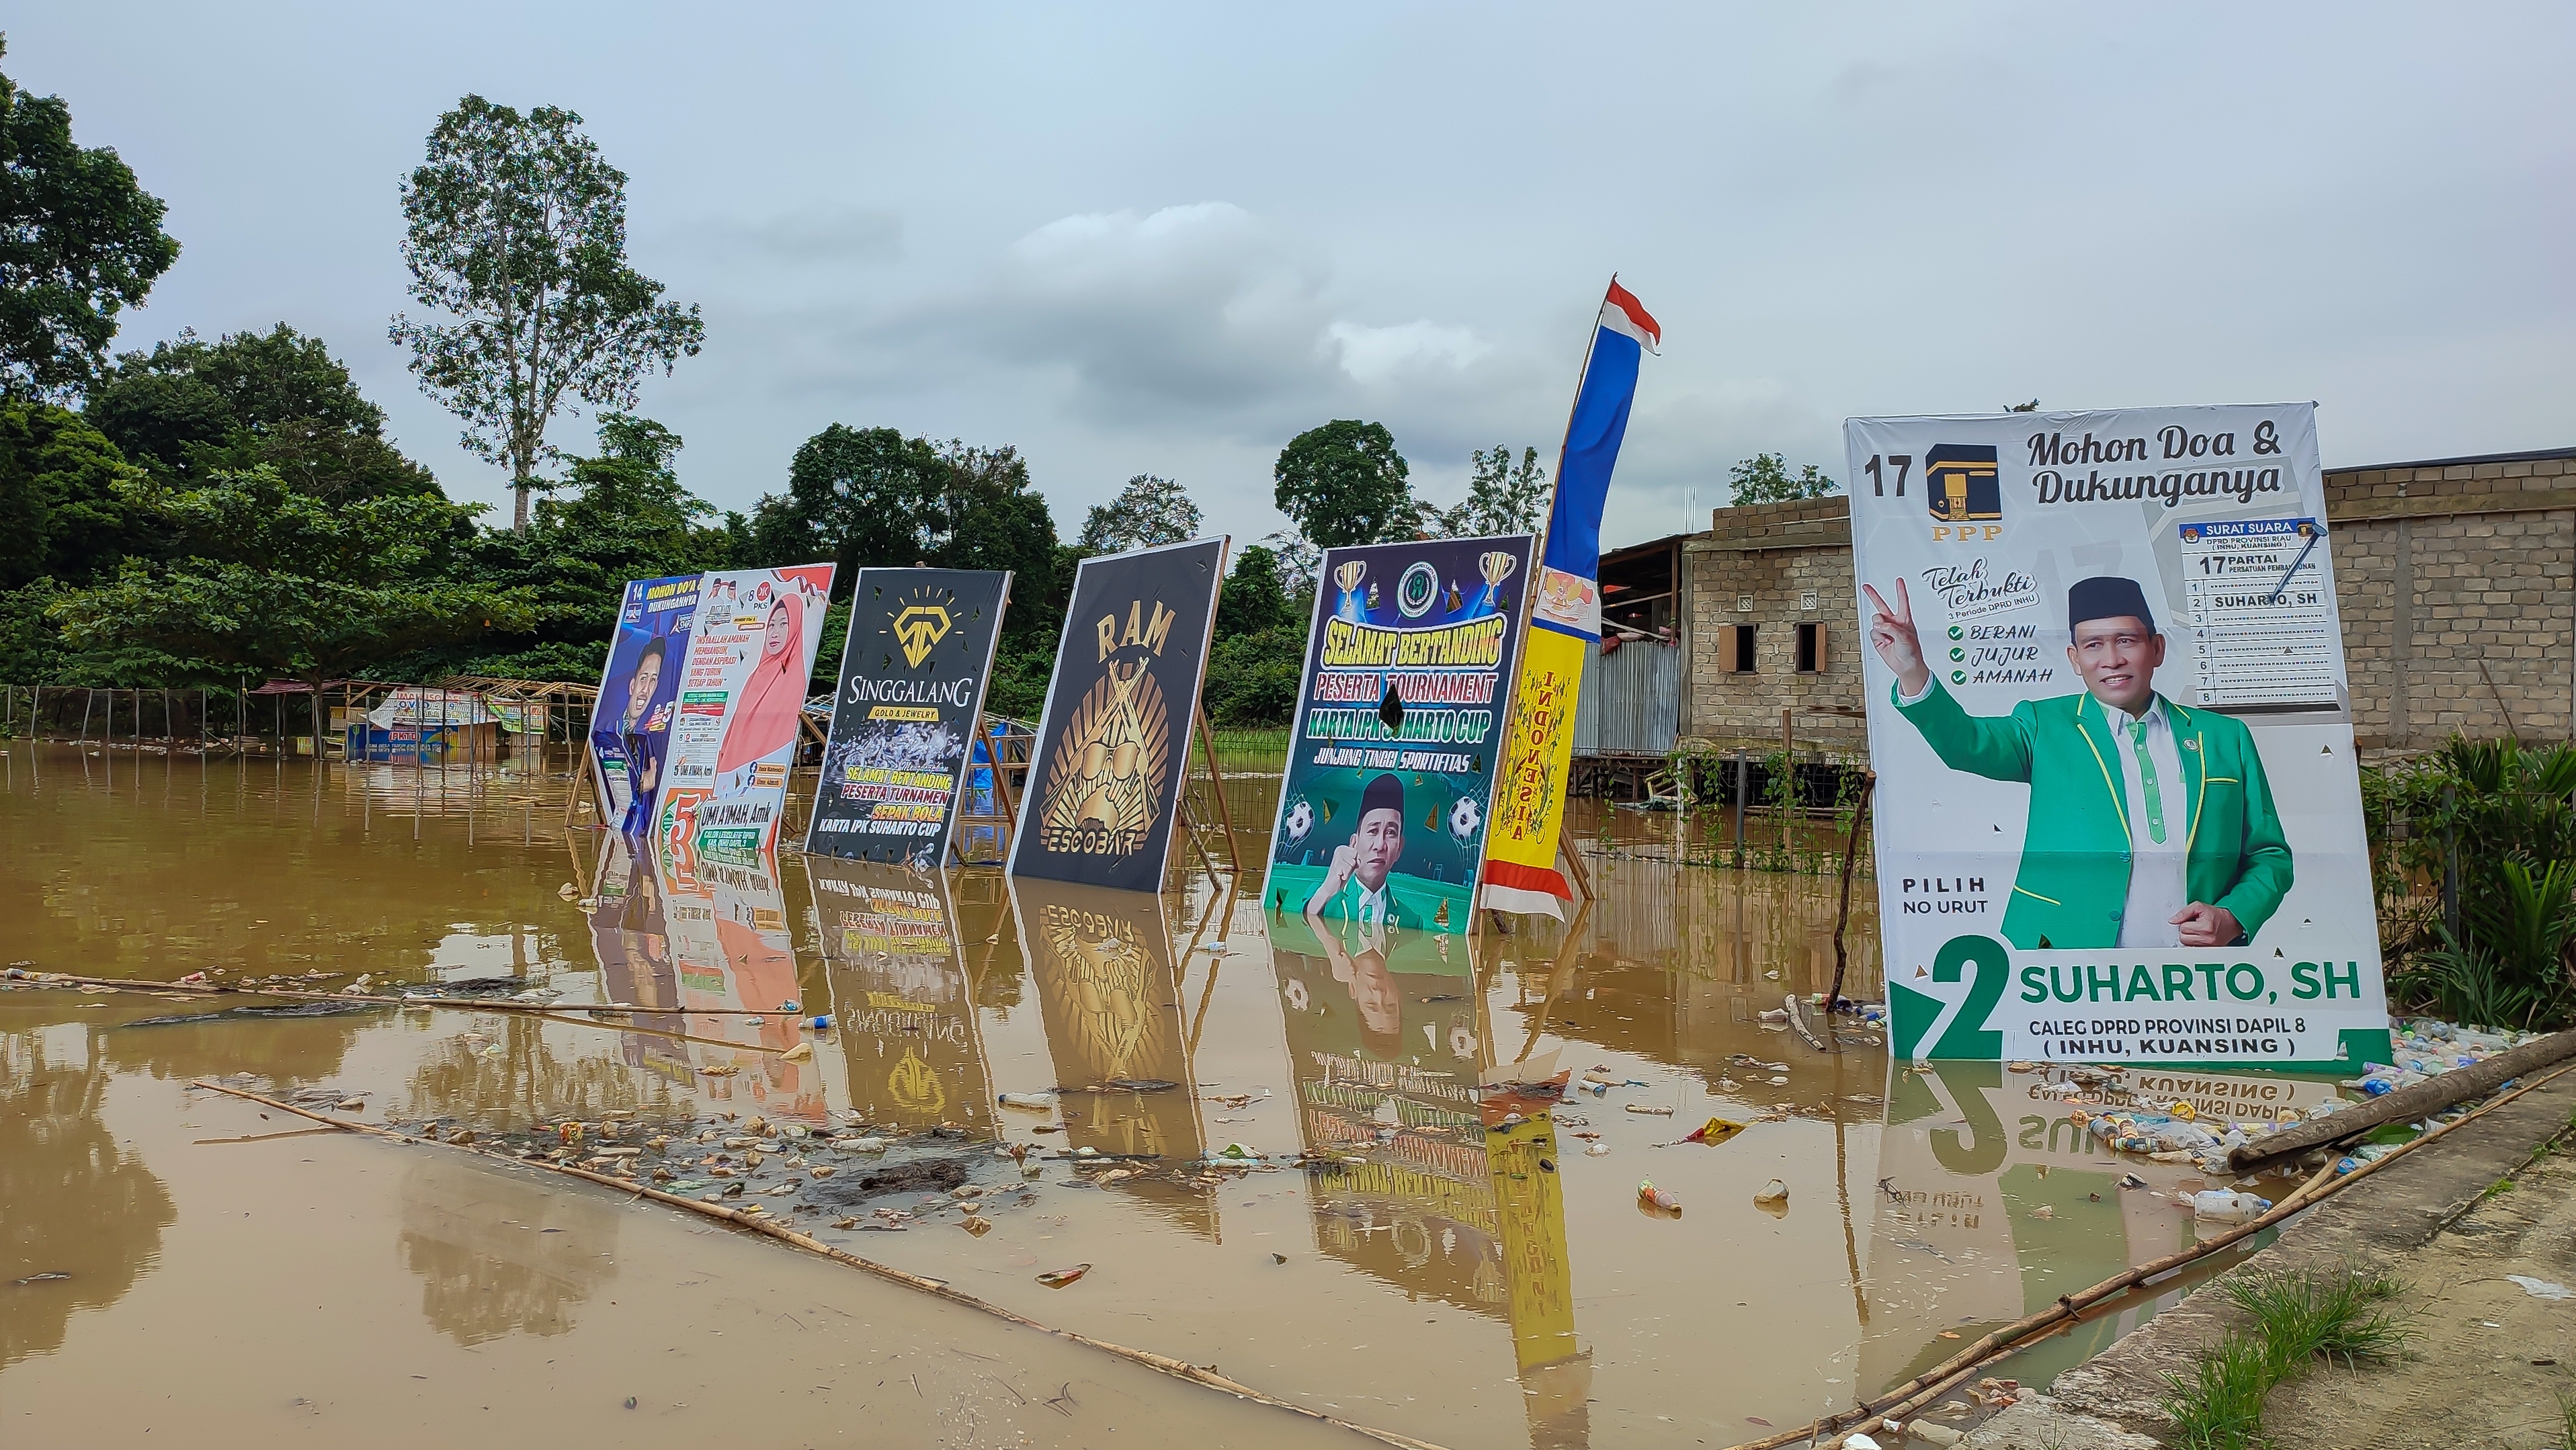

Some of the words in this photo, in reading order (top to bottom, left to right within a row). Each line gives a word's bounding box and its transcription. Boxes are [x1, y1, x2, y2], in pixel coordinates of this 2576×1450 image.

[2027, 432, 2149, 466] Mohon
[2157, 425, 2236, 460] Doa
[2253, 420, 2282, 455] &
[1864, 454, 1912, 497] 17
[2032, 468, 2280, 508] Dukunganya
[1931, 525, 2003, 542] PPP
[2206, 525, 2245, 536] SURAT
[2248, 522, 2293, 534] SUARA
[2199, 556, 2227, 574] 17
[2227, 554, 2278, 565] PARTAI
[1921, 558, 1984, 591] Telah
[633, 583, 643, 601] 14
[646, 583, 677, 600] MOHON
[748, 589, 755, 602] 8
[1937, 572, 2034, 609] Terbukti
[2192, 583, 2198, 592] 1
[647, 594, 697, 613] DUKUNGANNYA
[753, 602, 768, 610] PKS
[1956, 607, 1987, 619] Periode
[1988, 600, 2012, 611] DPRD
[2013, 595, 2035, 605] INHU
[2193, 599, 2201, 607] 2
[2296, 593, 2318, 604] SH
[2195, 614, 2202, 623] 3
[1097, 599, 1176, 663] RAM
[1969, 625, 2036, 640] BERANI
[2196, 630, 2204, 638] 4
[1323, 620, 1397, 665] SELAMAT
[1397, 618, 1503, 665] BERTANDING
[2198, 645, 2206, 654] 5
[1970, 646, 2038, 667] JUJUR
[2200, 661, 2208, 670] 6
[1972, 668, 2053, 684] AMANAH
[2201, 677, 2208, 685] 7
[847, 675, 973, 708] SINGGALANG
[1315, 673, 1379, 701] PESERTA
[2203, 693, 2210, 702] 8
[895, 710, 901, 718] &
[901, 710, 936, 719] JEWELRY
[1308, 710, 1356, 738] KARTA
[1455, 711, 1492, 742] CUP
[1313, 747, 1362, 767] JUNJUNG
[1363, 749, 1399, 768] TINGGI
[1399, 752, 1471, 772] SPORTIFITAS
[673, 765, 679, 776] 5
[846, 765, 890, 783] SELAMAT
[890, 771, 954, 791] BERTANDING
[840, 784, 888, 801] PESERTA
[888, 787, 951, 804] TURNAMEN
[701, 806, 720, 826] UMI
[749, 801, 772, 823] Amk
[872, 804, 912, 821] SEPAK
[912, 805, 944, 822] BOLA
[817, 819, 850, 833] KARTA
[849, 820, 870, 834] IPK
[869, 821, 918, 836] SUHARTO
[917, 822, 942, 837] CUP
[1046, 829, 1137, 856] ESCOBAR
[1903, 878, 1985, 894] PILIH
[1903, 901, 1931, 914] NO
[1937, 900, 1989, 914] URUT
[2020, 962, 2278, 1005] SUHARTO,
[2290, 961, 2361, 1000] SH
[1926, 935, 2009, 1060] 2
[2029, 1020, 2087, 1036] CALEG
[2091, 1019, 2141, 1035] DPRD
[2145, 1018, 2232, 1035] PROVINSI
[2235, 1017, 2291, 1033] DAPIL
[2294, 1017, 2307, 1033] 8
[2059, 1039, 2132, 1058] INHU,
[2139, 1038, 2279, 1055] KUANSING
